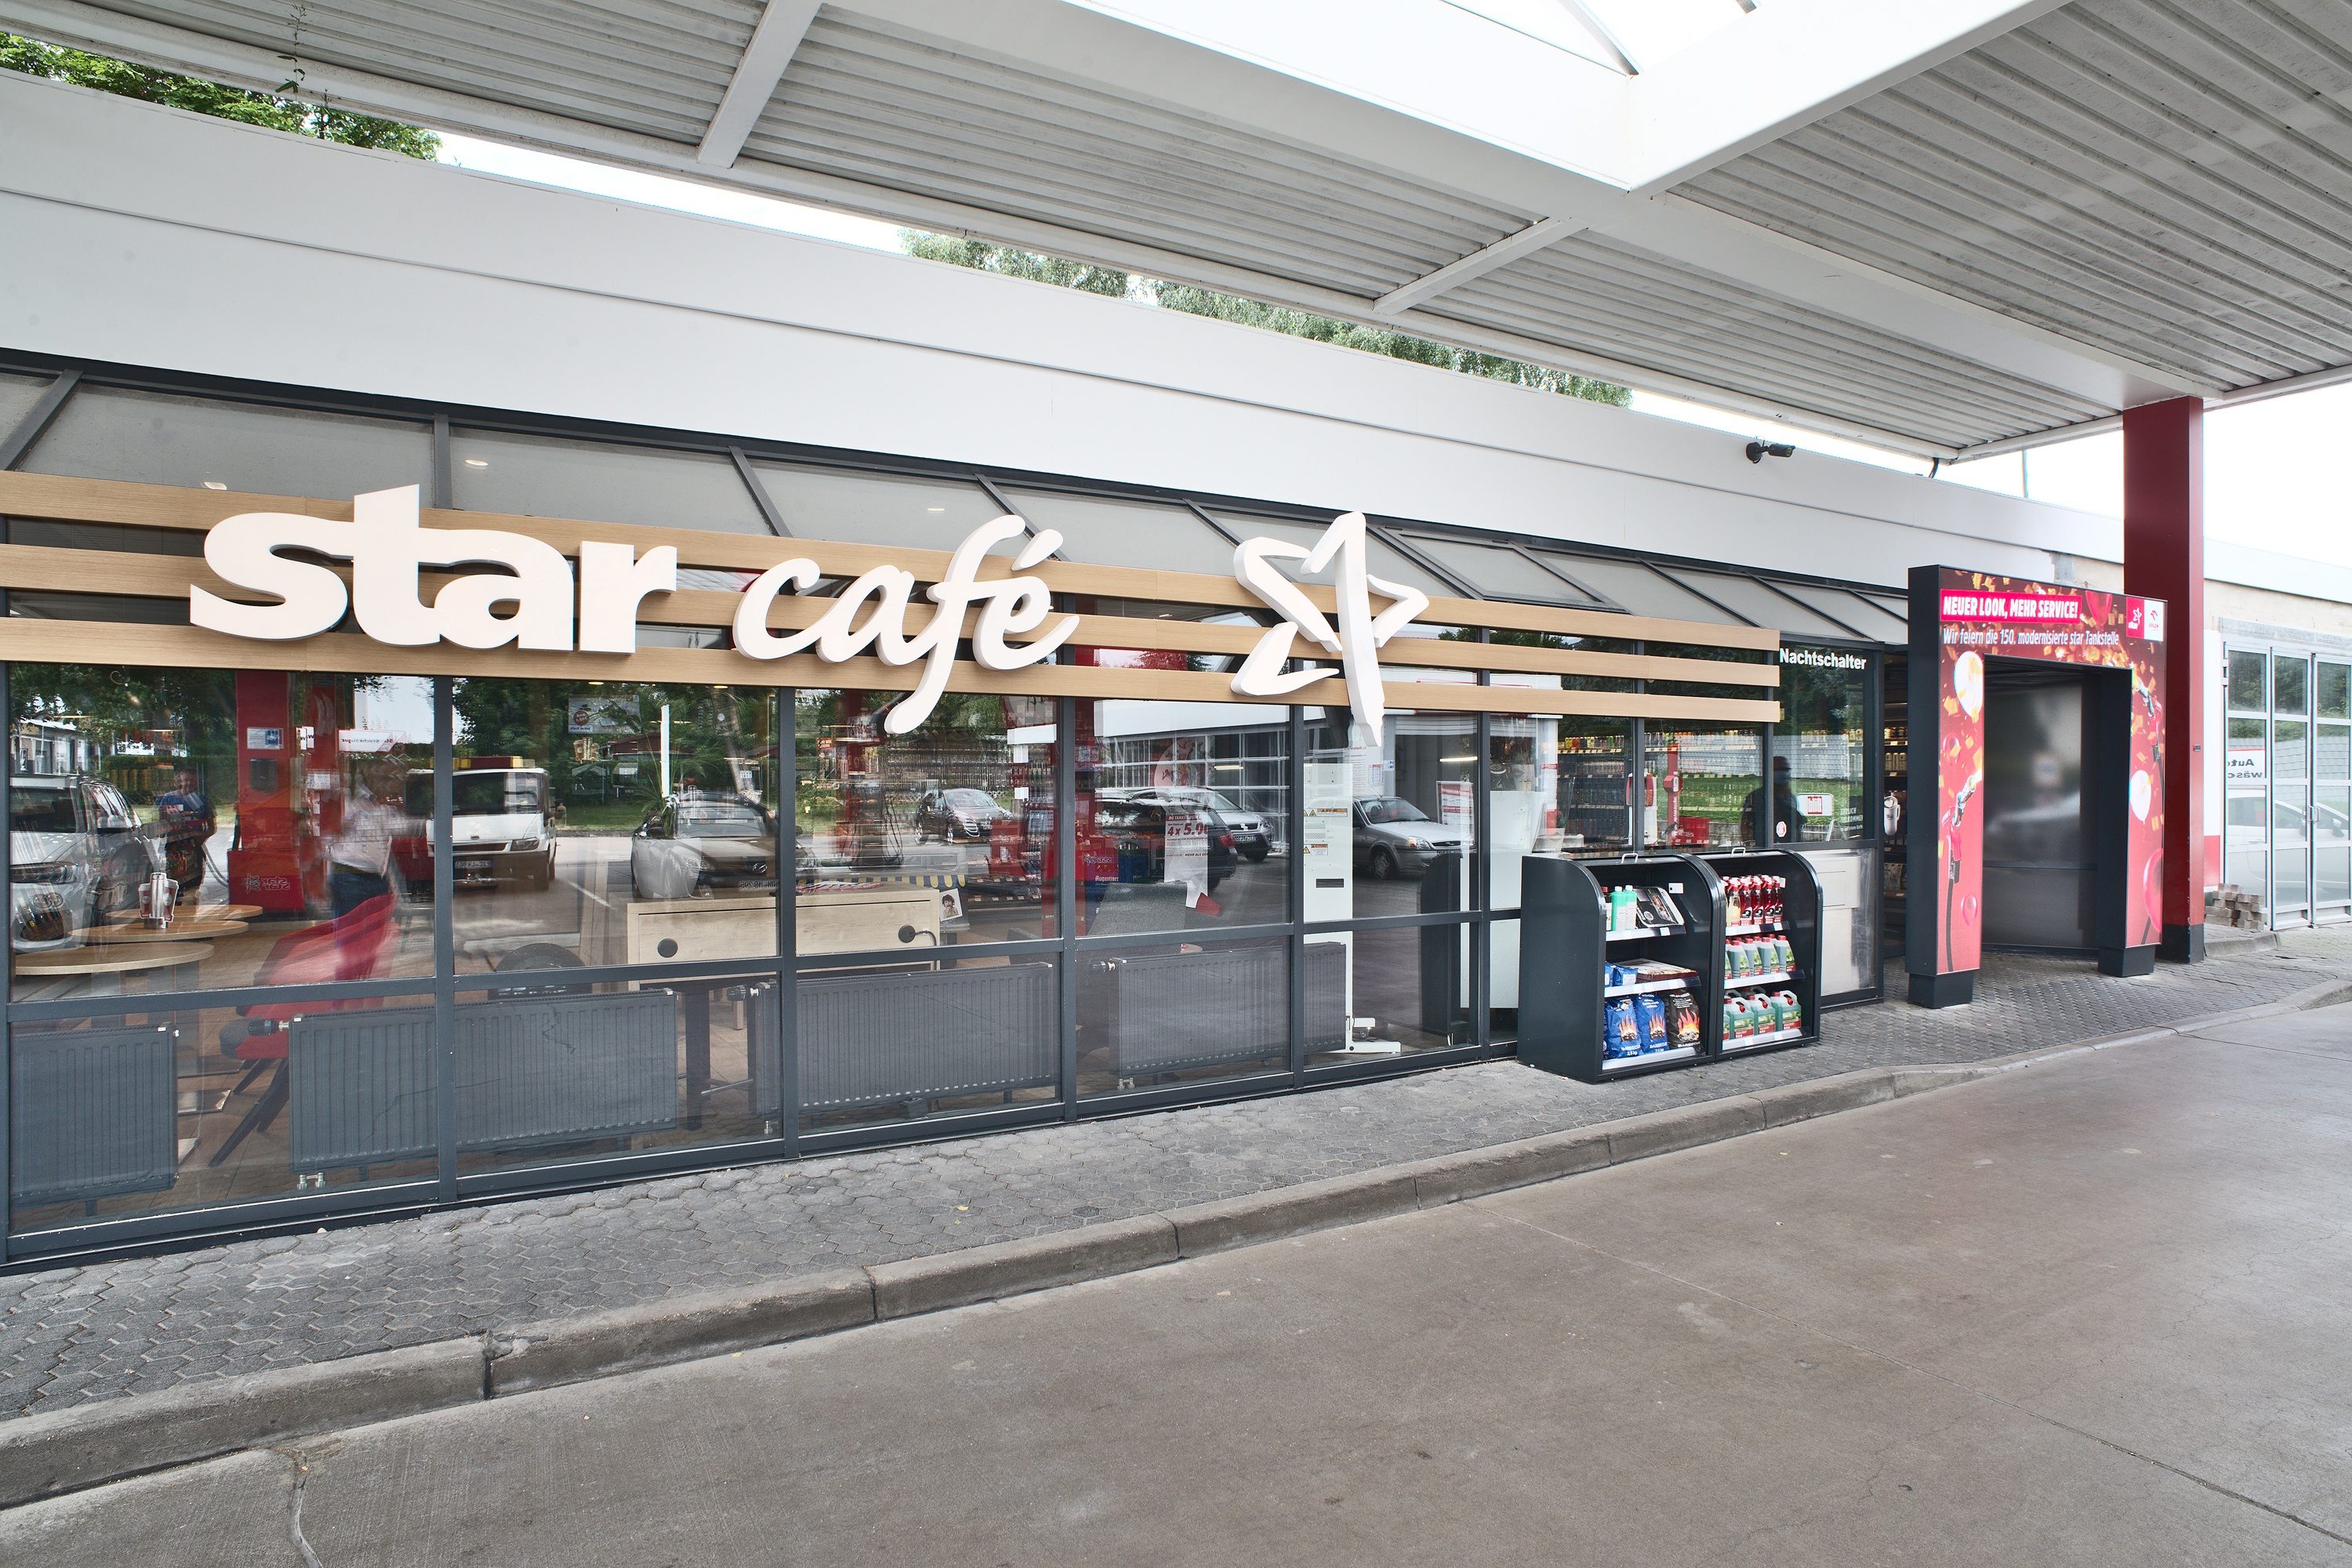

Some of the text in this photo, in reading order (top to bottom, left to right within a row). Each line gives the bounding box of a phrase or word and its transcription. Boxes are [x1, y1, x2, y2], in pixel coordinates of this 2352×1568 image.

[190, 484, 1080, 734] star café
[1943, 596, 2078, 619] NEUER LOOK, MEHR SERVICE!
[1942, 628, 2119, 645] Wir feiern die 150. modernisierte star Tankstelle
[1779, 648, 1867, 670] Nachtschalter
